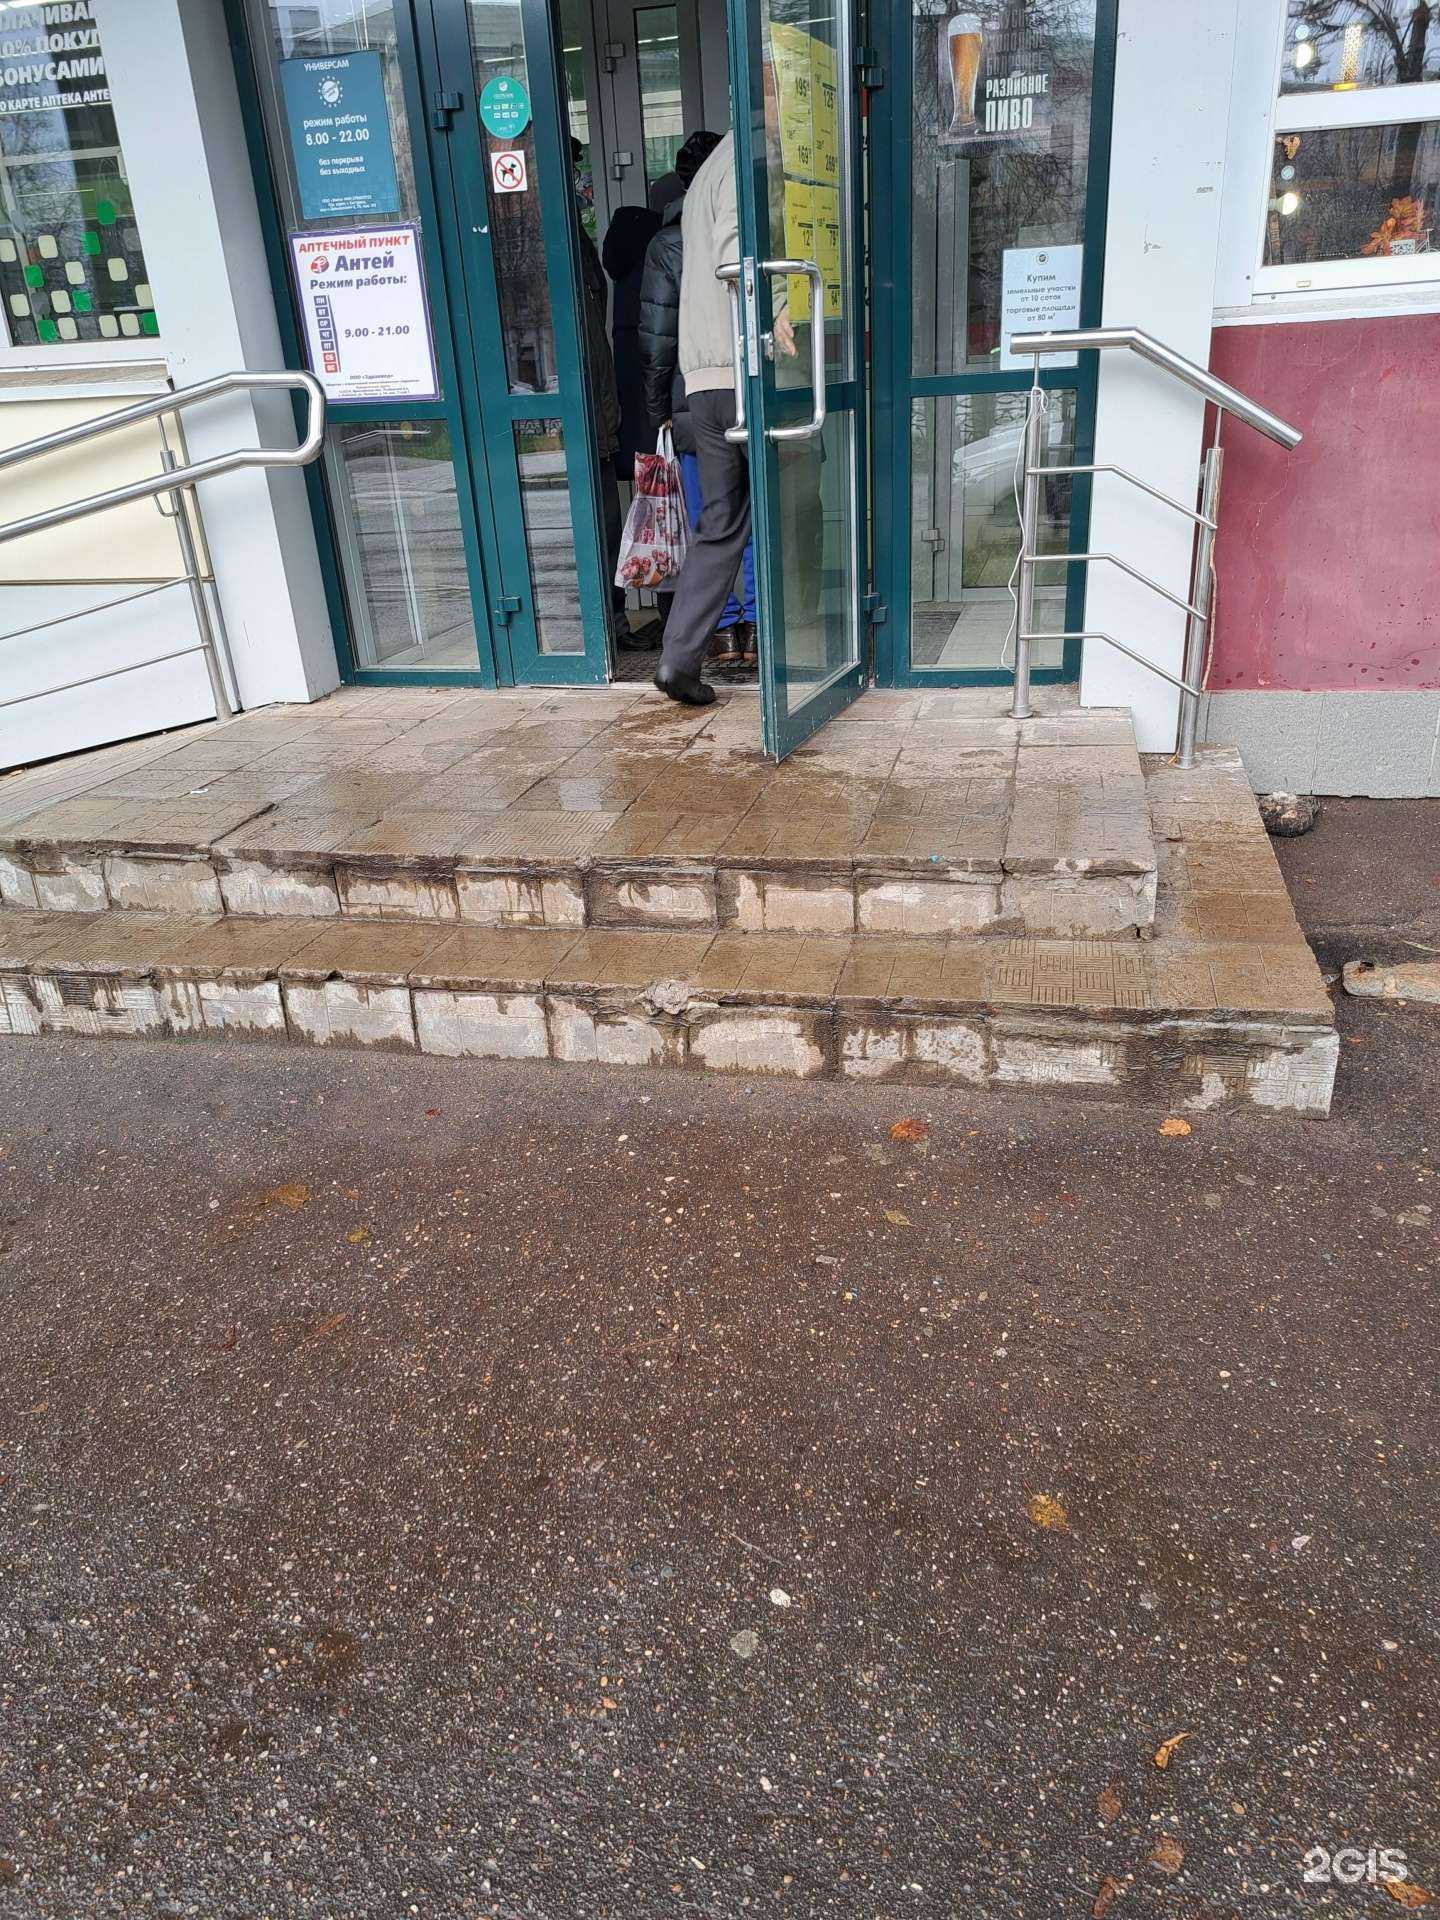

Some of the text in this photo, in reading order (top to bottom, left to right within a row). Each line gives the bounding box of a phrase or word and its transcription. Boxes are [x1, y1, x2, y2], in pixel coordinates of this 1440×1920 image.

[304, 59, 350, 72] УНИВЕРСАМ
[986, 74, 1049, 98] РАЗЛИВНОЕ
[8, 96, 40, 111] КАРТЕ
[42, 91, 82, 107] АПТЕКА
[304, 114, 368, 131] режим работы
[985, 97, 1033, 132] ПИВО
[305, 131, 329, 146] 8.00
[339, 129, 370, 143] 22.00
[319, 158, 331, 166] без
[319, 168, 331, 176] без
[299, 235, 410, 253] АПТЕЧНЫЙ ПУНКТ
[335, 250, 395, 272] Антей
[310, 274, 408, 290] Режим работы:
[1027, 274, 1056, 284] Купим
[1007, 285, 1077, 295] земельные участки
[1006, 306, 1041, 314] торговые
[344, 328, 369, 338] 9.00
[378, 325, 410, 337] 21.00
